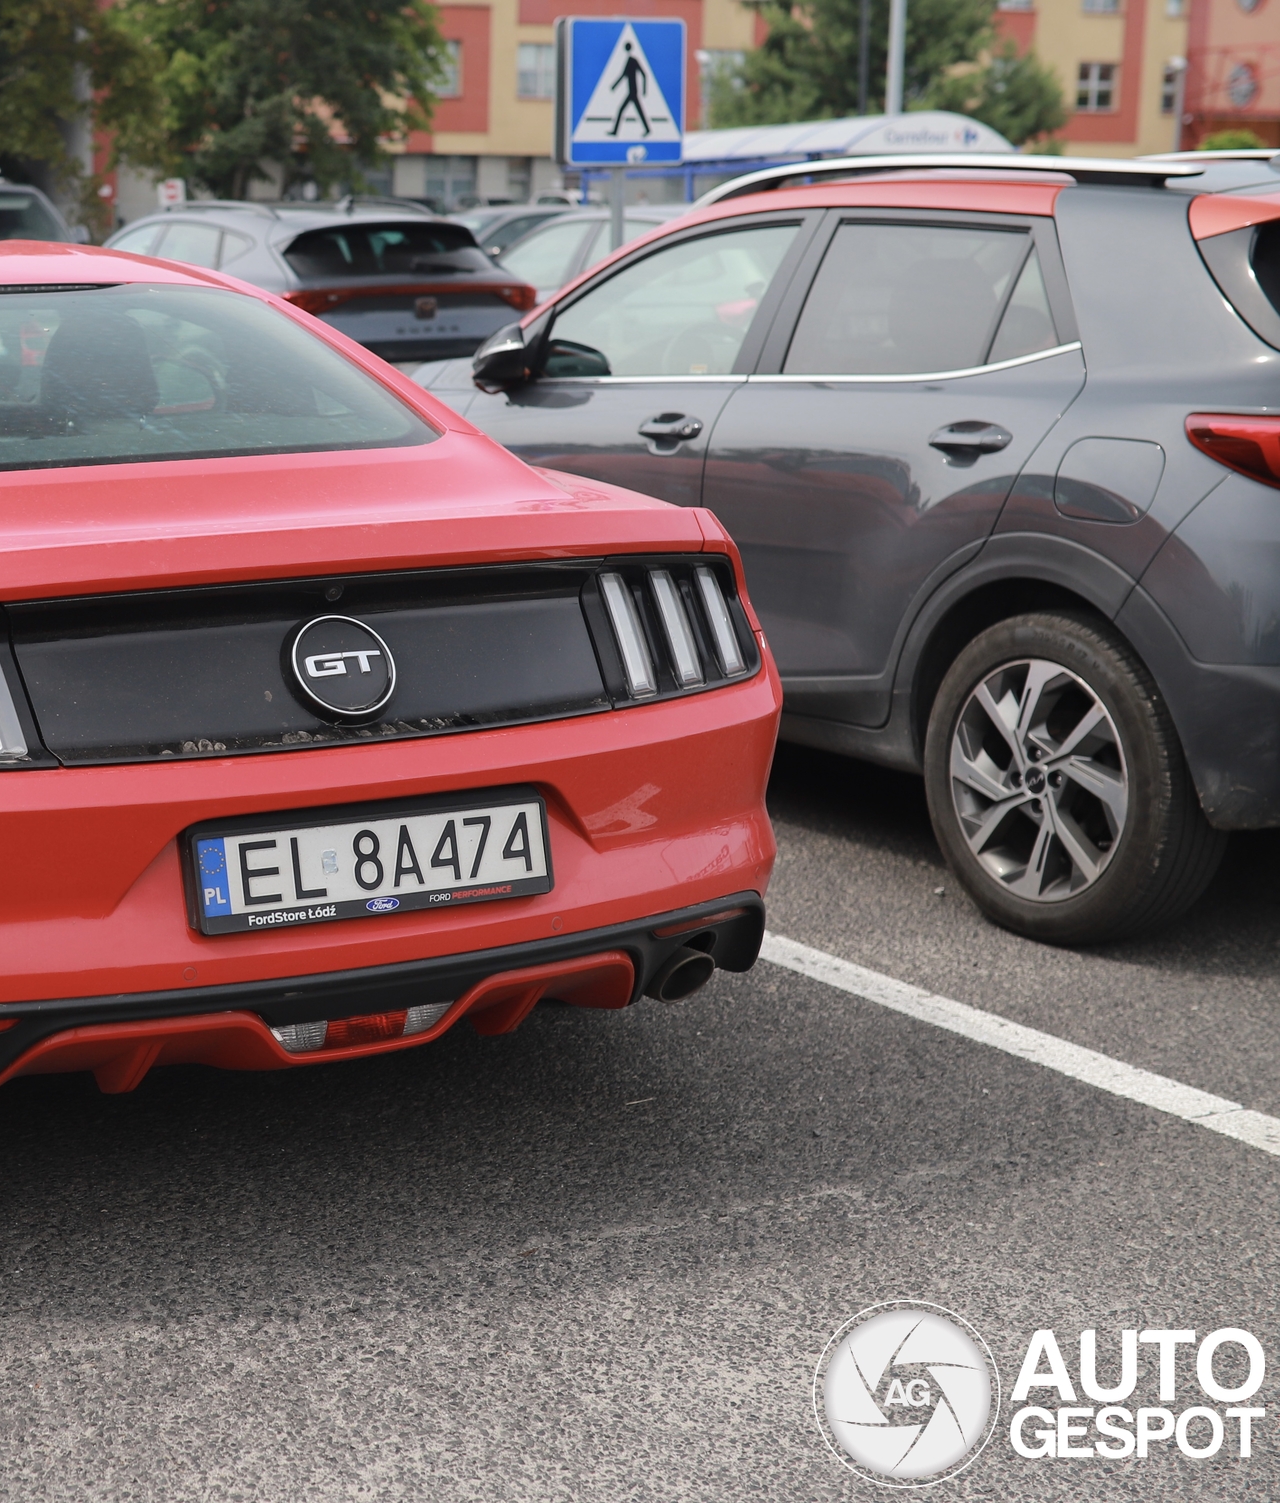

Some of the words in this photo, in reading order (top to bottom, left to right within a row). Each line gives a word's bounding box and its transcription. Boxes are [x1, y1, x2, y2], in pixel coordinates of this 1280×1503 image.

[305, 650, 380, 678] GT
[238, 837, 327, 906] EL
[353, 811, 532, 891] 8A474
[204, 887, 226, 906] PL
[429, 892, 451, 903] FORD
[451, 885, 512, 899] PERFORMANCE
[371, 899, 395, 910] Ford
[248, 911, 307, 926] FordStore
[308, 904, 336, 919] Łódź
